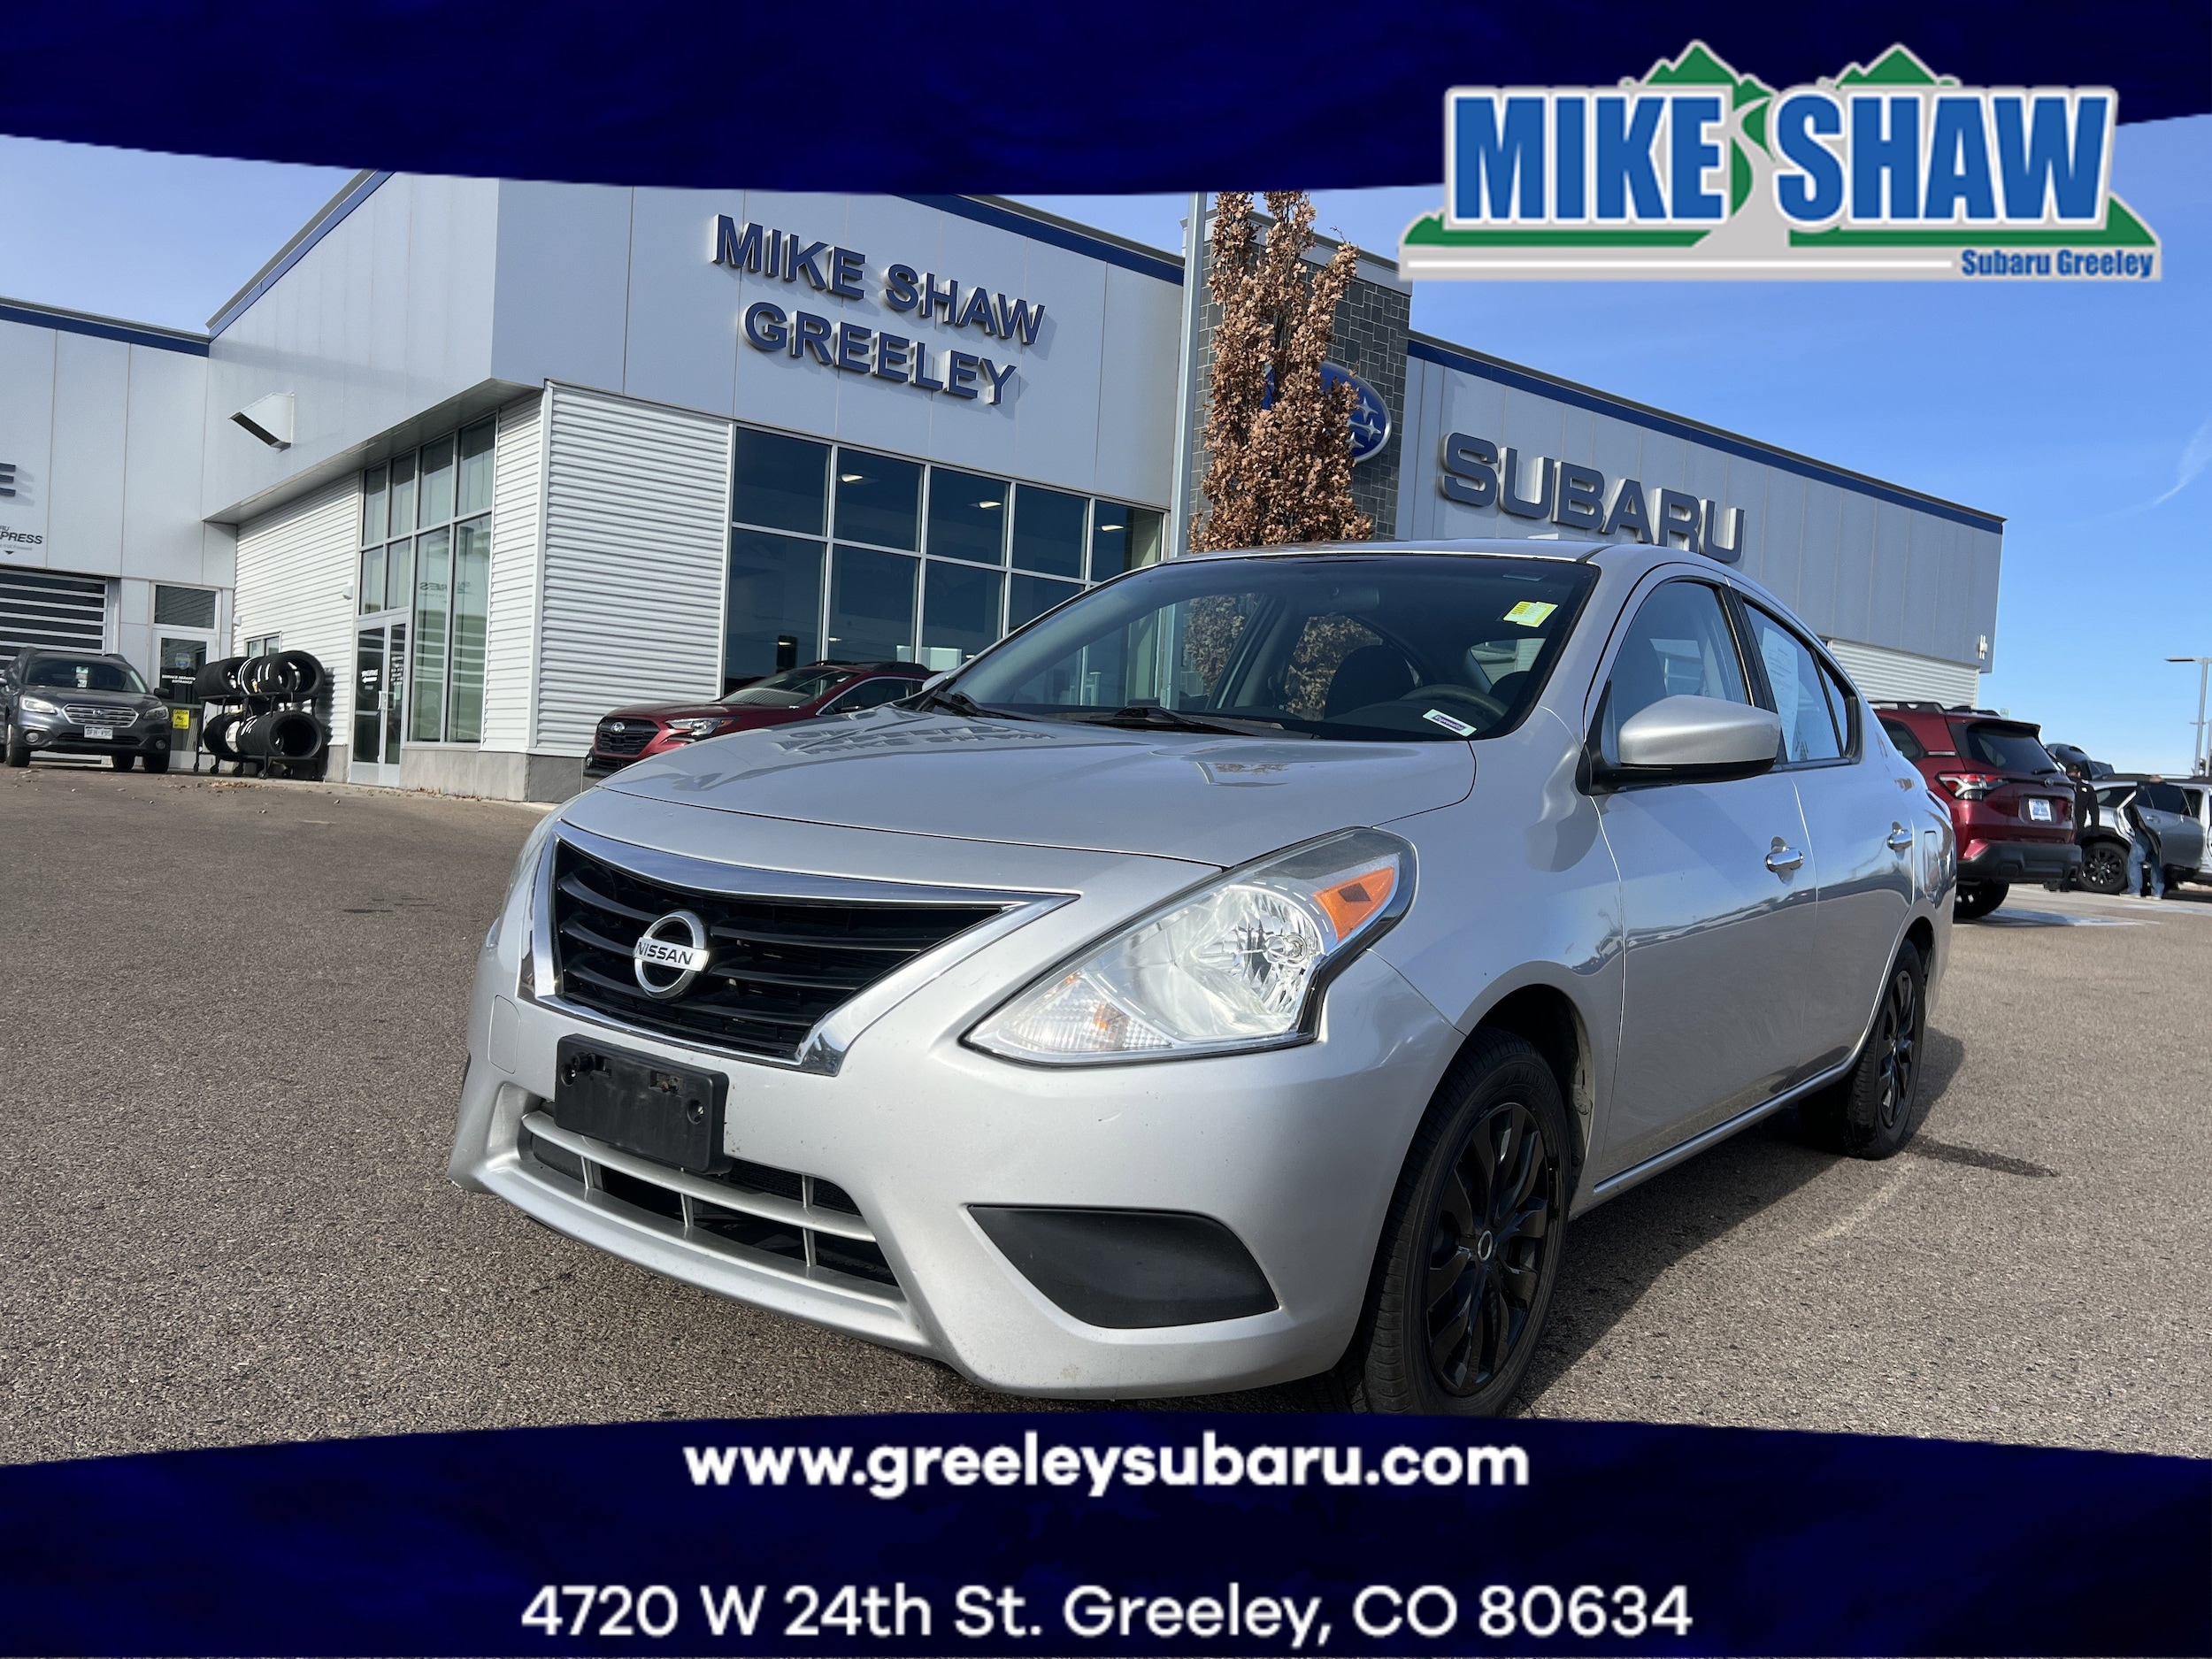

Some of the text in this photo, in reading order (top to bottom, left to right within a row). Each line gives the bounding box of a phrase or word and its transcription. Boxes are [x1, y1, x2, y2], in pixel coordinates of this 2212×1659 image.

[715, 214, 1046, 345] MIKE SHAW
[743, 301, 1018, 405] GREELEY
[1440, 432, 1746, 563] SUBARU
[636, 941, 694, 965] NISSAN
